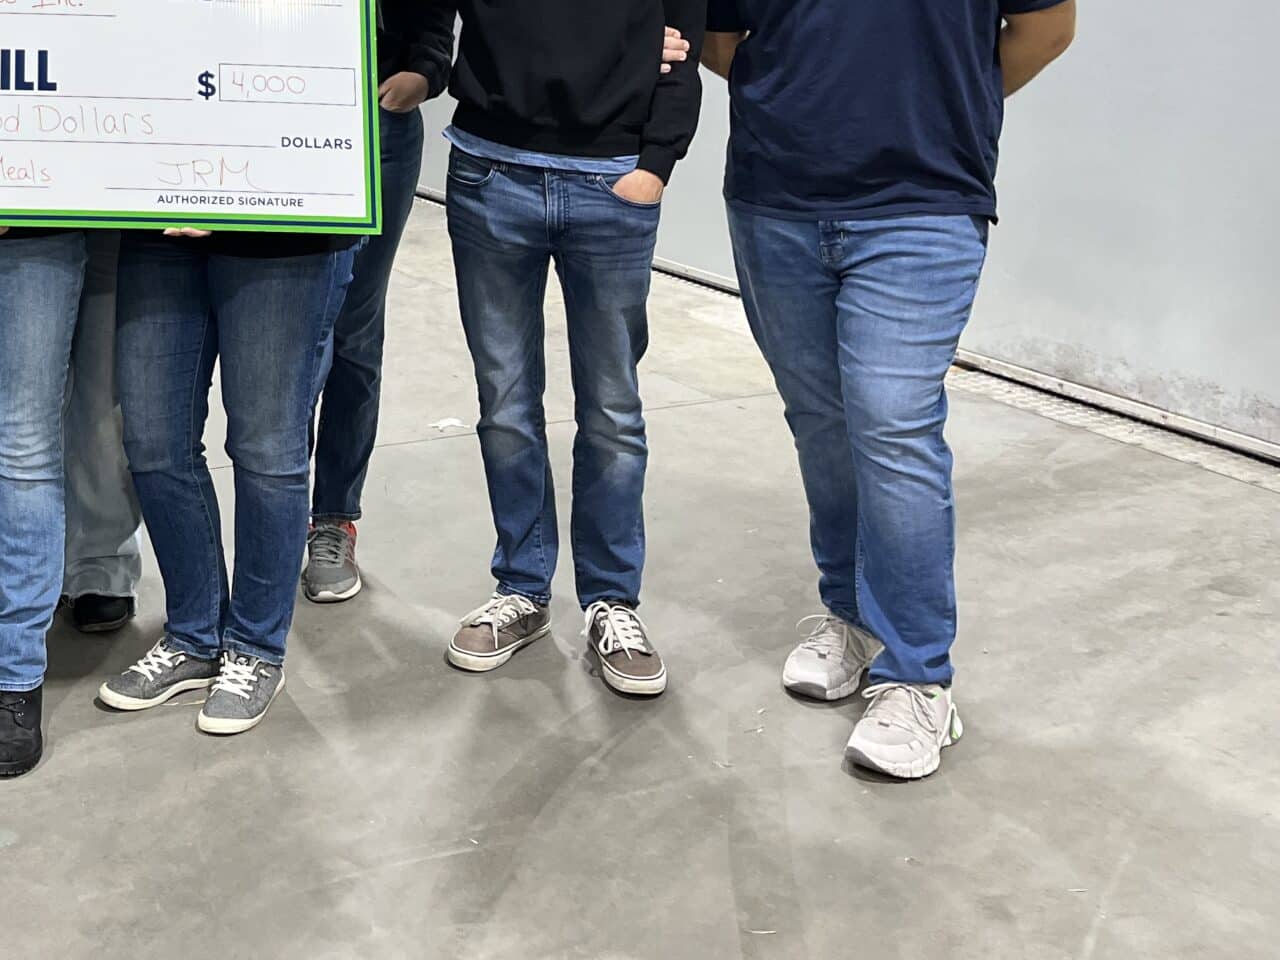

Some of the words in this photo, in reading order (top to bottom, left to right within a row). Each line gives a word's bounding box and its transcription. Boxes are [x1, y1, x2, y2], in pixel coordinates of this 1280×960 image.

[197, 71, 216, 100] $
[232, 71, 306, 99] 4,000
[33, 104, 154, 135] Dollars
[281, 136, 353, 150] DOLLARS
[157, 195, 234, 206] AUTHORIZED
[238, 197, 304, 207] SIGNATURE
